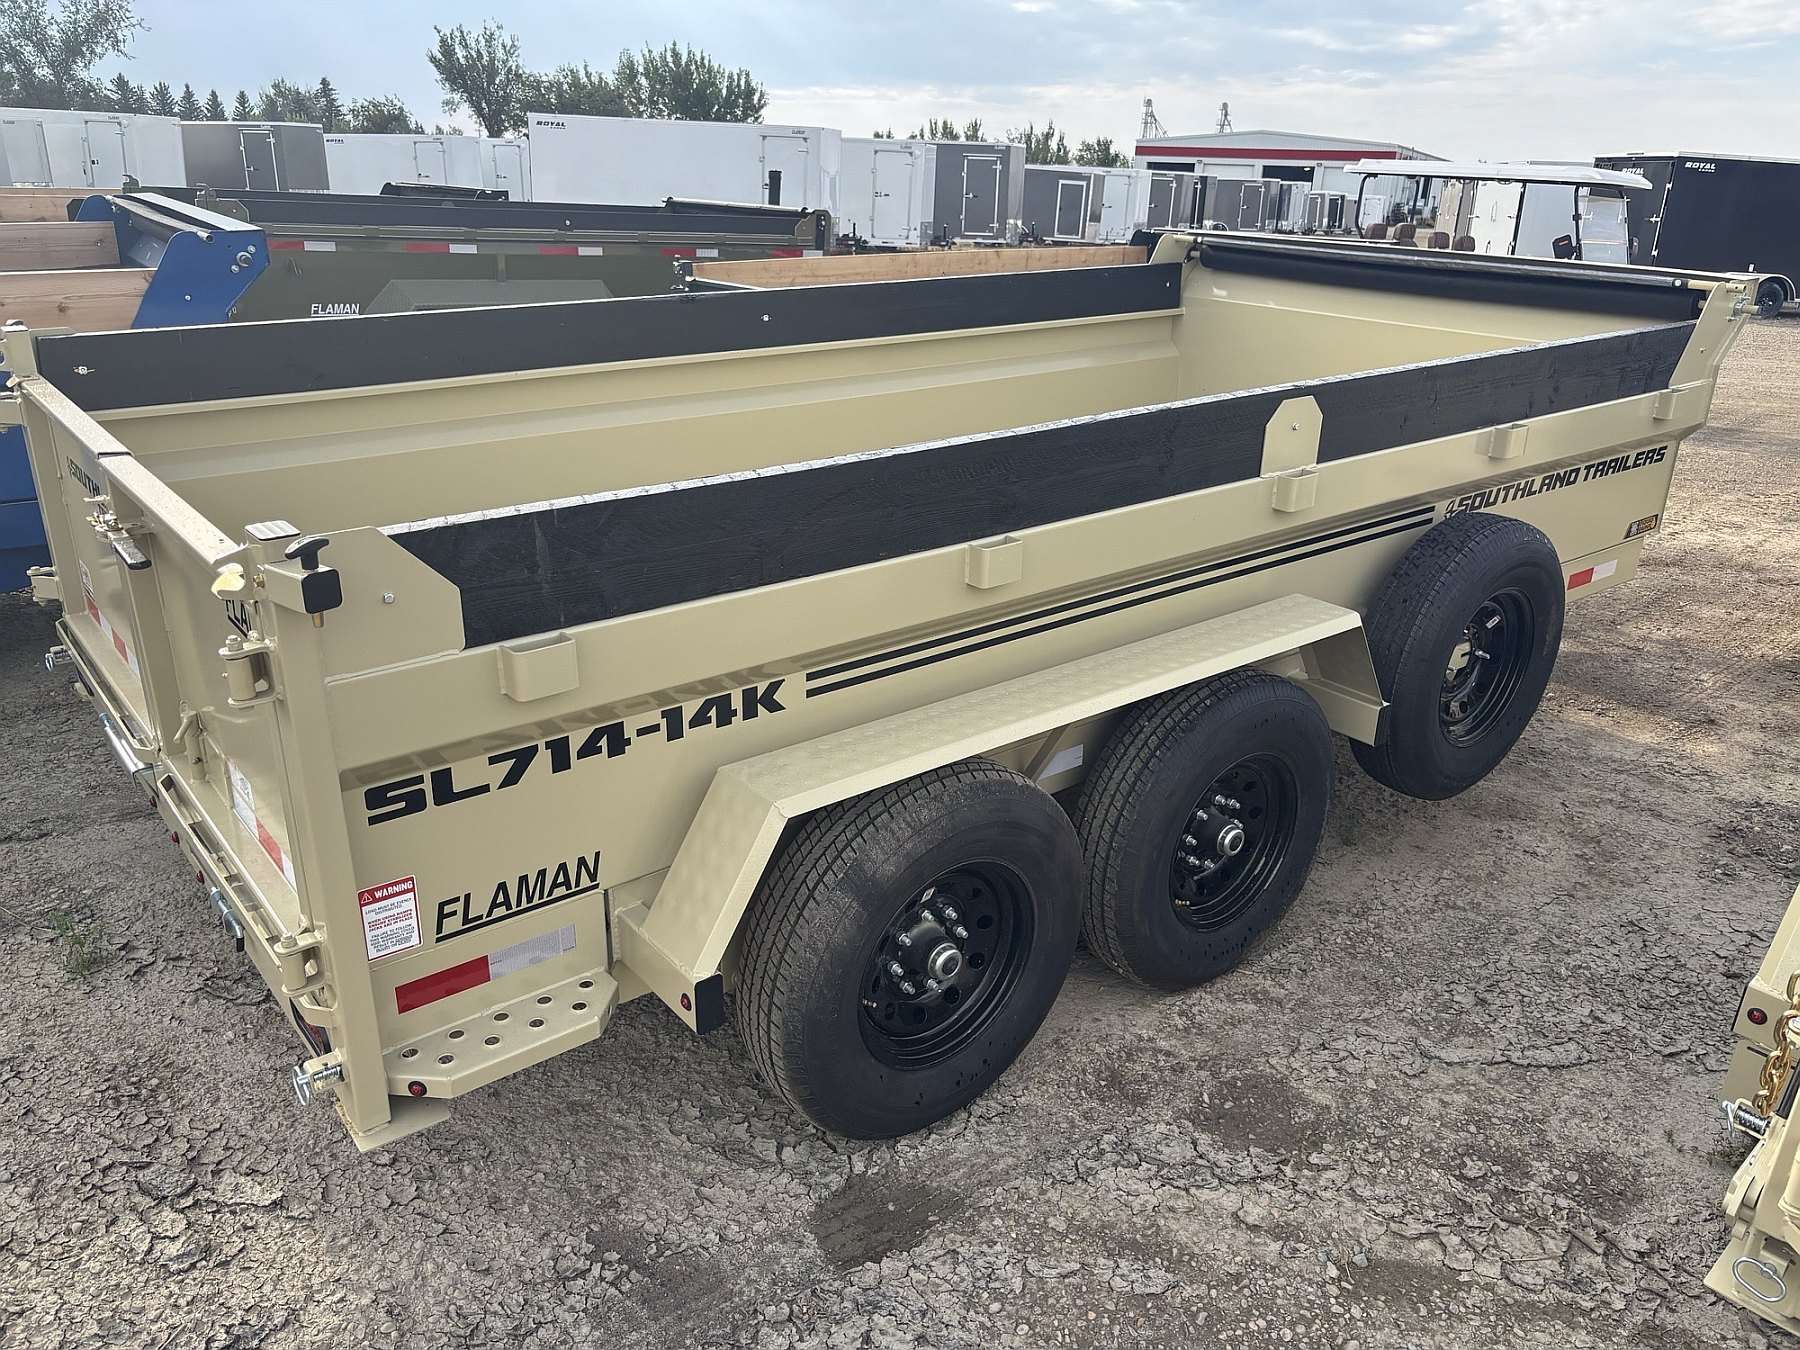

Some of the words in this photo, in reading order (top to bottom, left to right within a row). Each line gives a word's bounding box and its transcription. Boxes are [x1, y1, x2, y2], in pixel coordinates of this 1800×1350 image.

[1621, 166, 1644, 175] ROYAL
[1684, 161, 1716, 170] ROYAL
[311, 303, 360, 315] FLAMAN
[1457, 467, 1581, 513] SOUTHLAND
[1583, 445, 1668, 482] TRAILERS
[364, 679, 787, 826] SL714-14K
[374, 881, 413, 898] WARNING
[435, 851, 601, 939] FLAMAN
